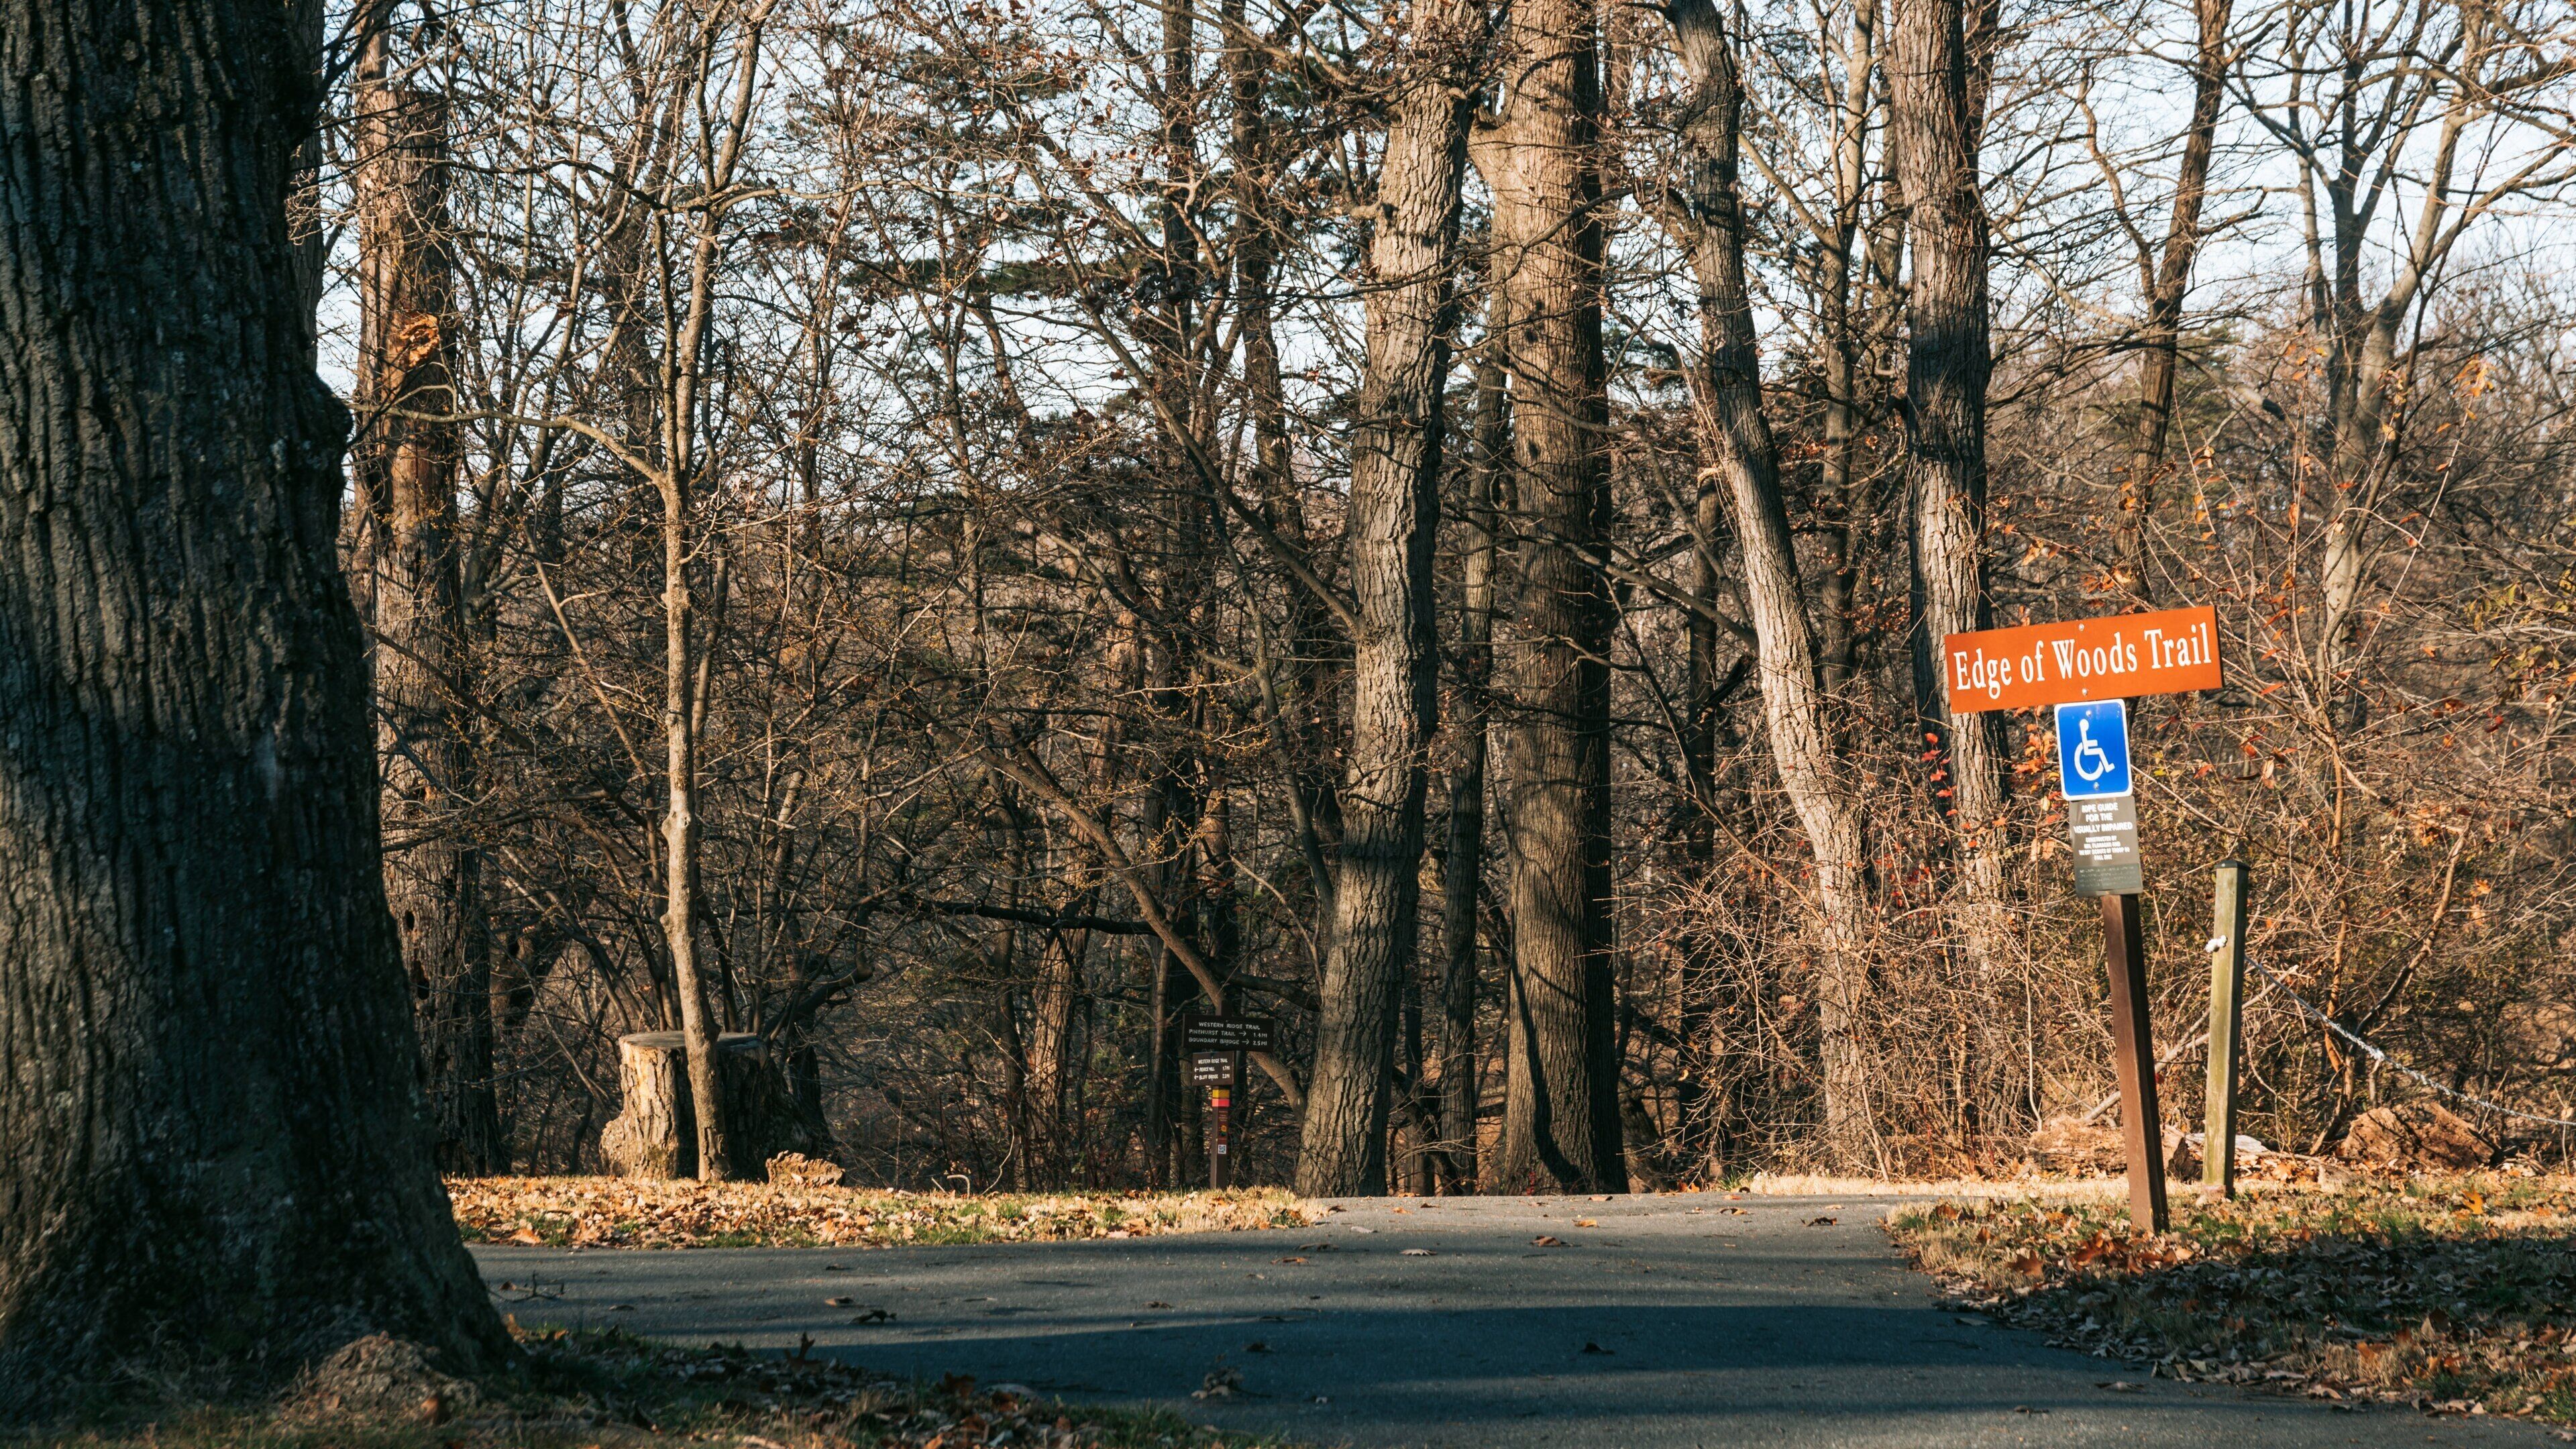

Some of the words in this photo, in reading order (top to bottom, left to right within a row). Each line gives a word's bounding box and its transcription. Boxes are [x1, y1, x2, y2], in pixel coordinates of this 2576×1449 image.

[1953, 648, 2012, 700] Edge
[2021, 640, 2045, 684] of
[2051, 631, 2138, 680] Woods
[2144, 622, 2212, 669] Trail
[2097, 802, 2118, 812] GUIDE
[2086, 813, 2100, 822] FOR
[2100, 812, 2113, 821] THE
[2073, 824, 2101, 834] VISUALLY
[2101, 821, 2133, 832] IMPAIRED
